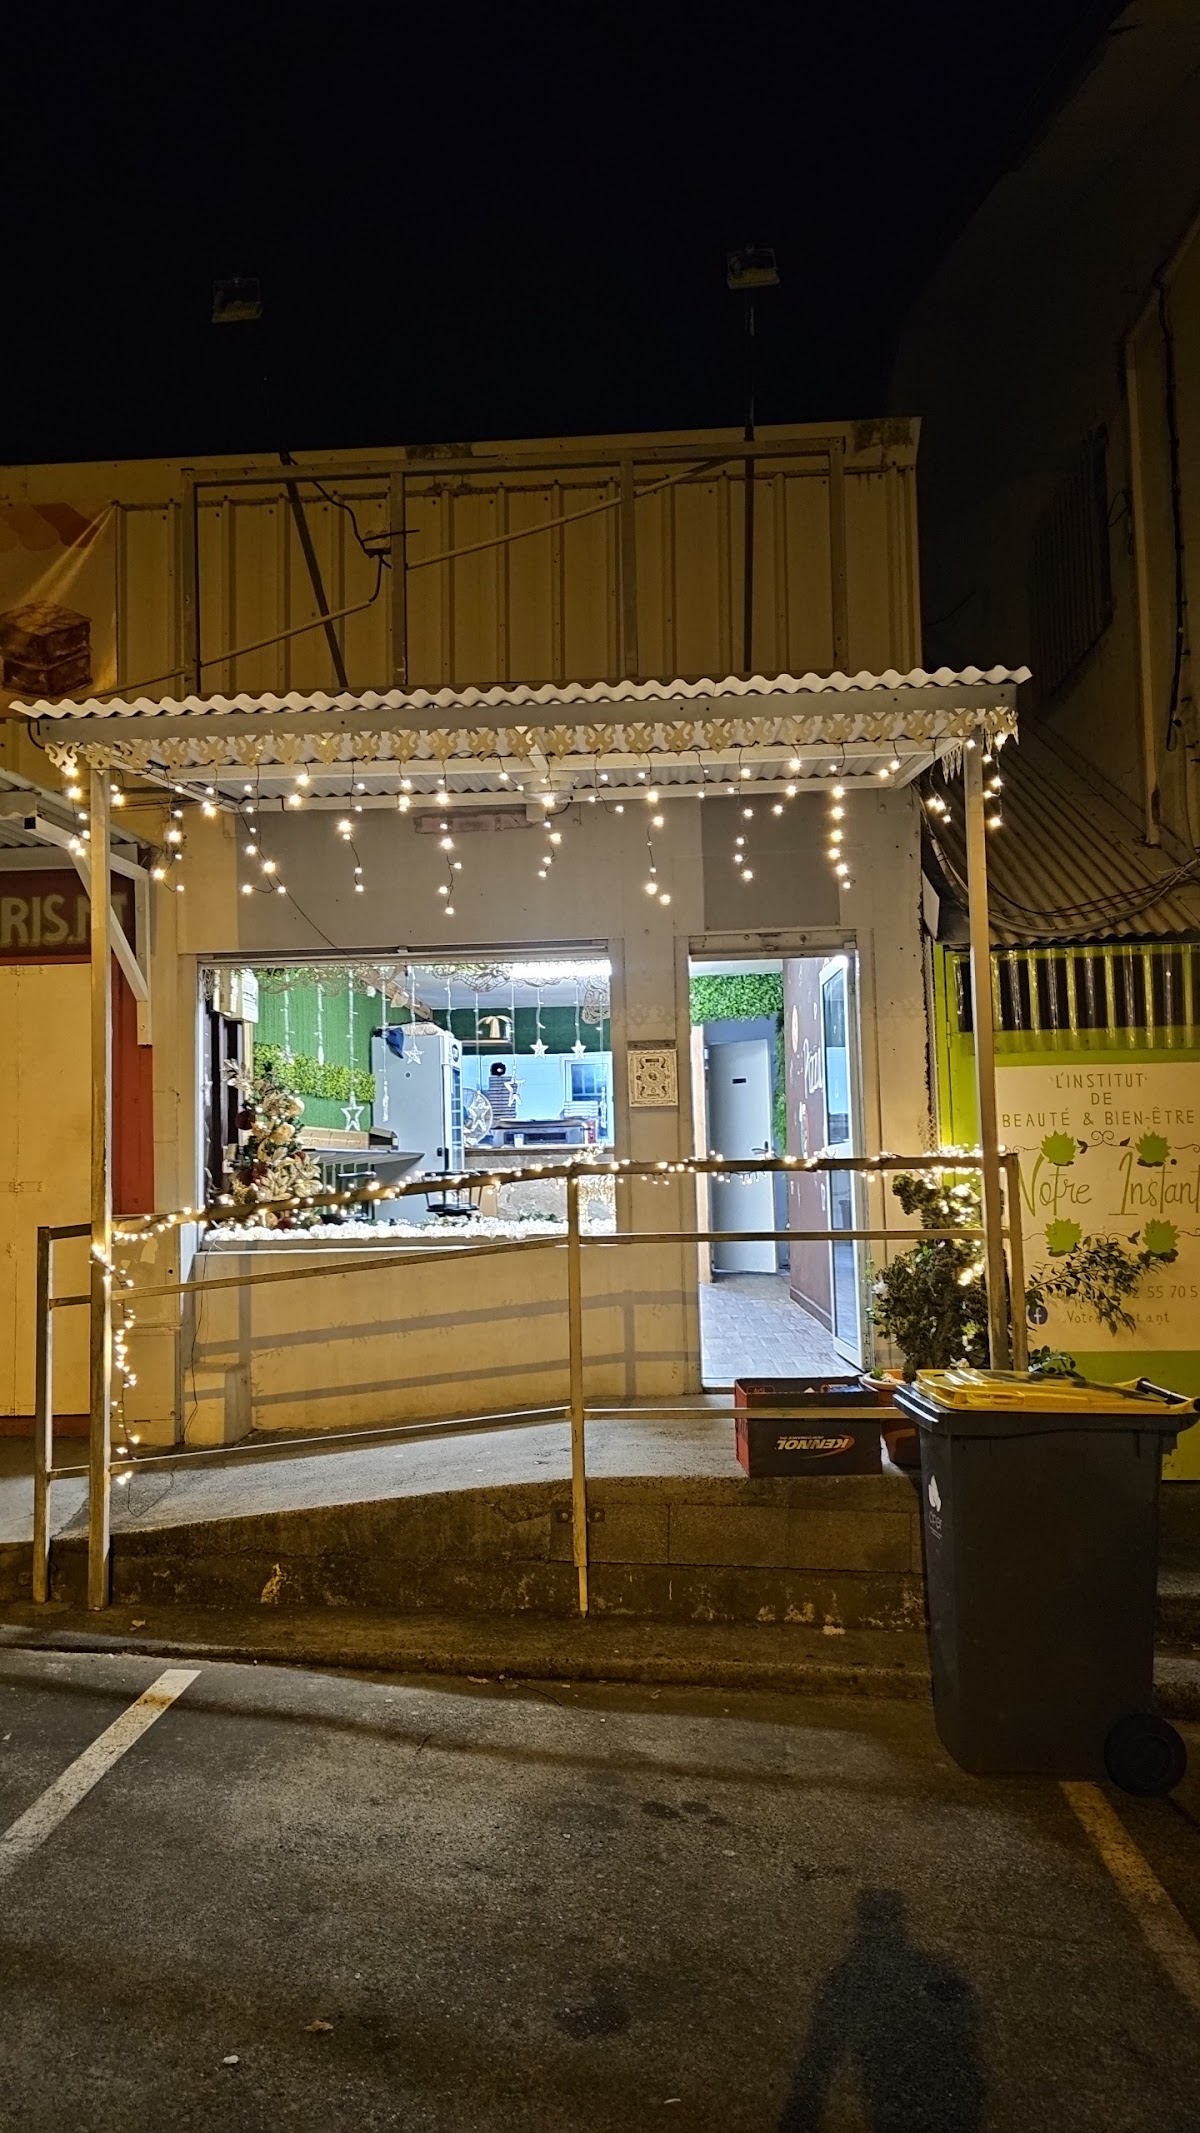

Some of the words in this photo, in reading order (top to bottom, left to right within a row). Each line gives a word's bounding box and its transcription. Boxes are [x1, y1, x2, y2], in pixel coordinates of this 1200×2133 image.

[1056, 1072, 1144, 1089] L'INSTITUT
[1091, 1092, 1112, 1105] DE
[1002, 1107, 1070, 1128] BEAUTÉ
[1083, 1112, 1094, 1126] &
[1104, 1106, 1195, 1126] BIEN-ÊTRE
[1147, 1285, 1164, 1299] 55
[1170, 1285, 1186, 1299] 70
[776, 1438, 850, 1450] KENNOL
